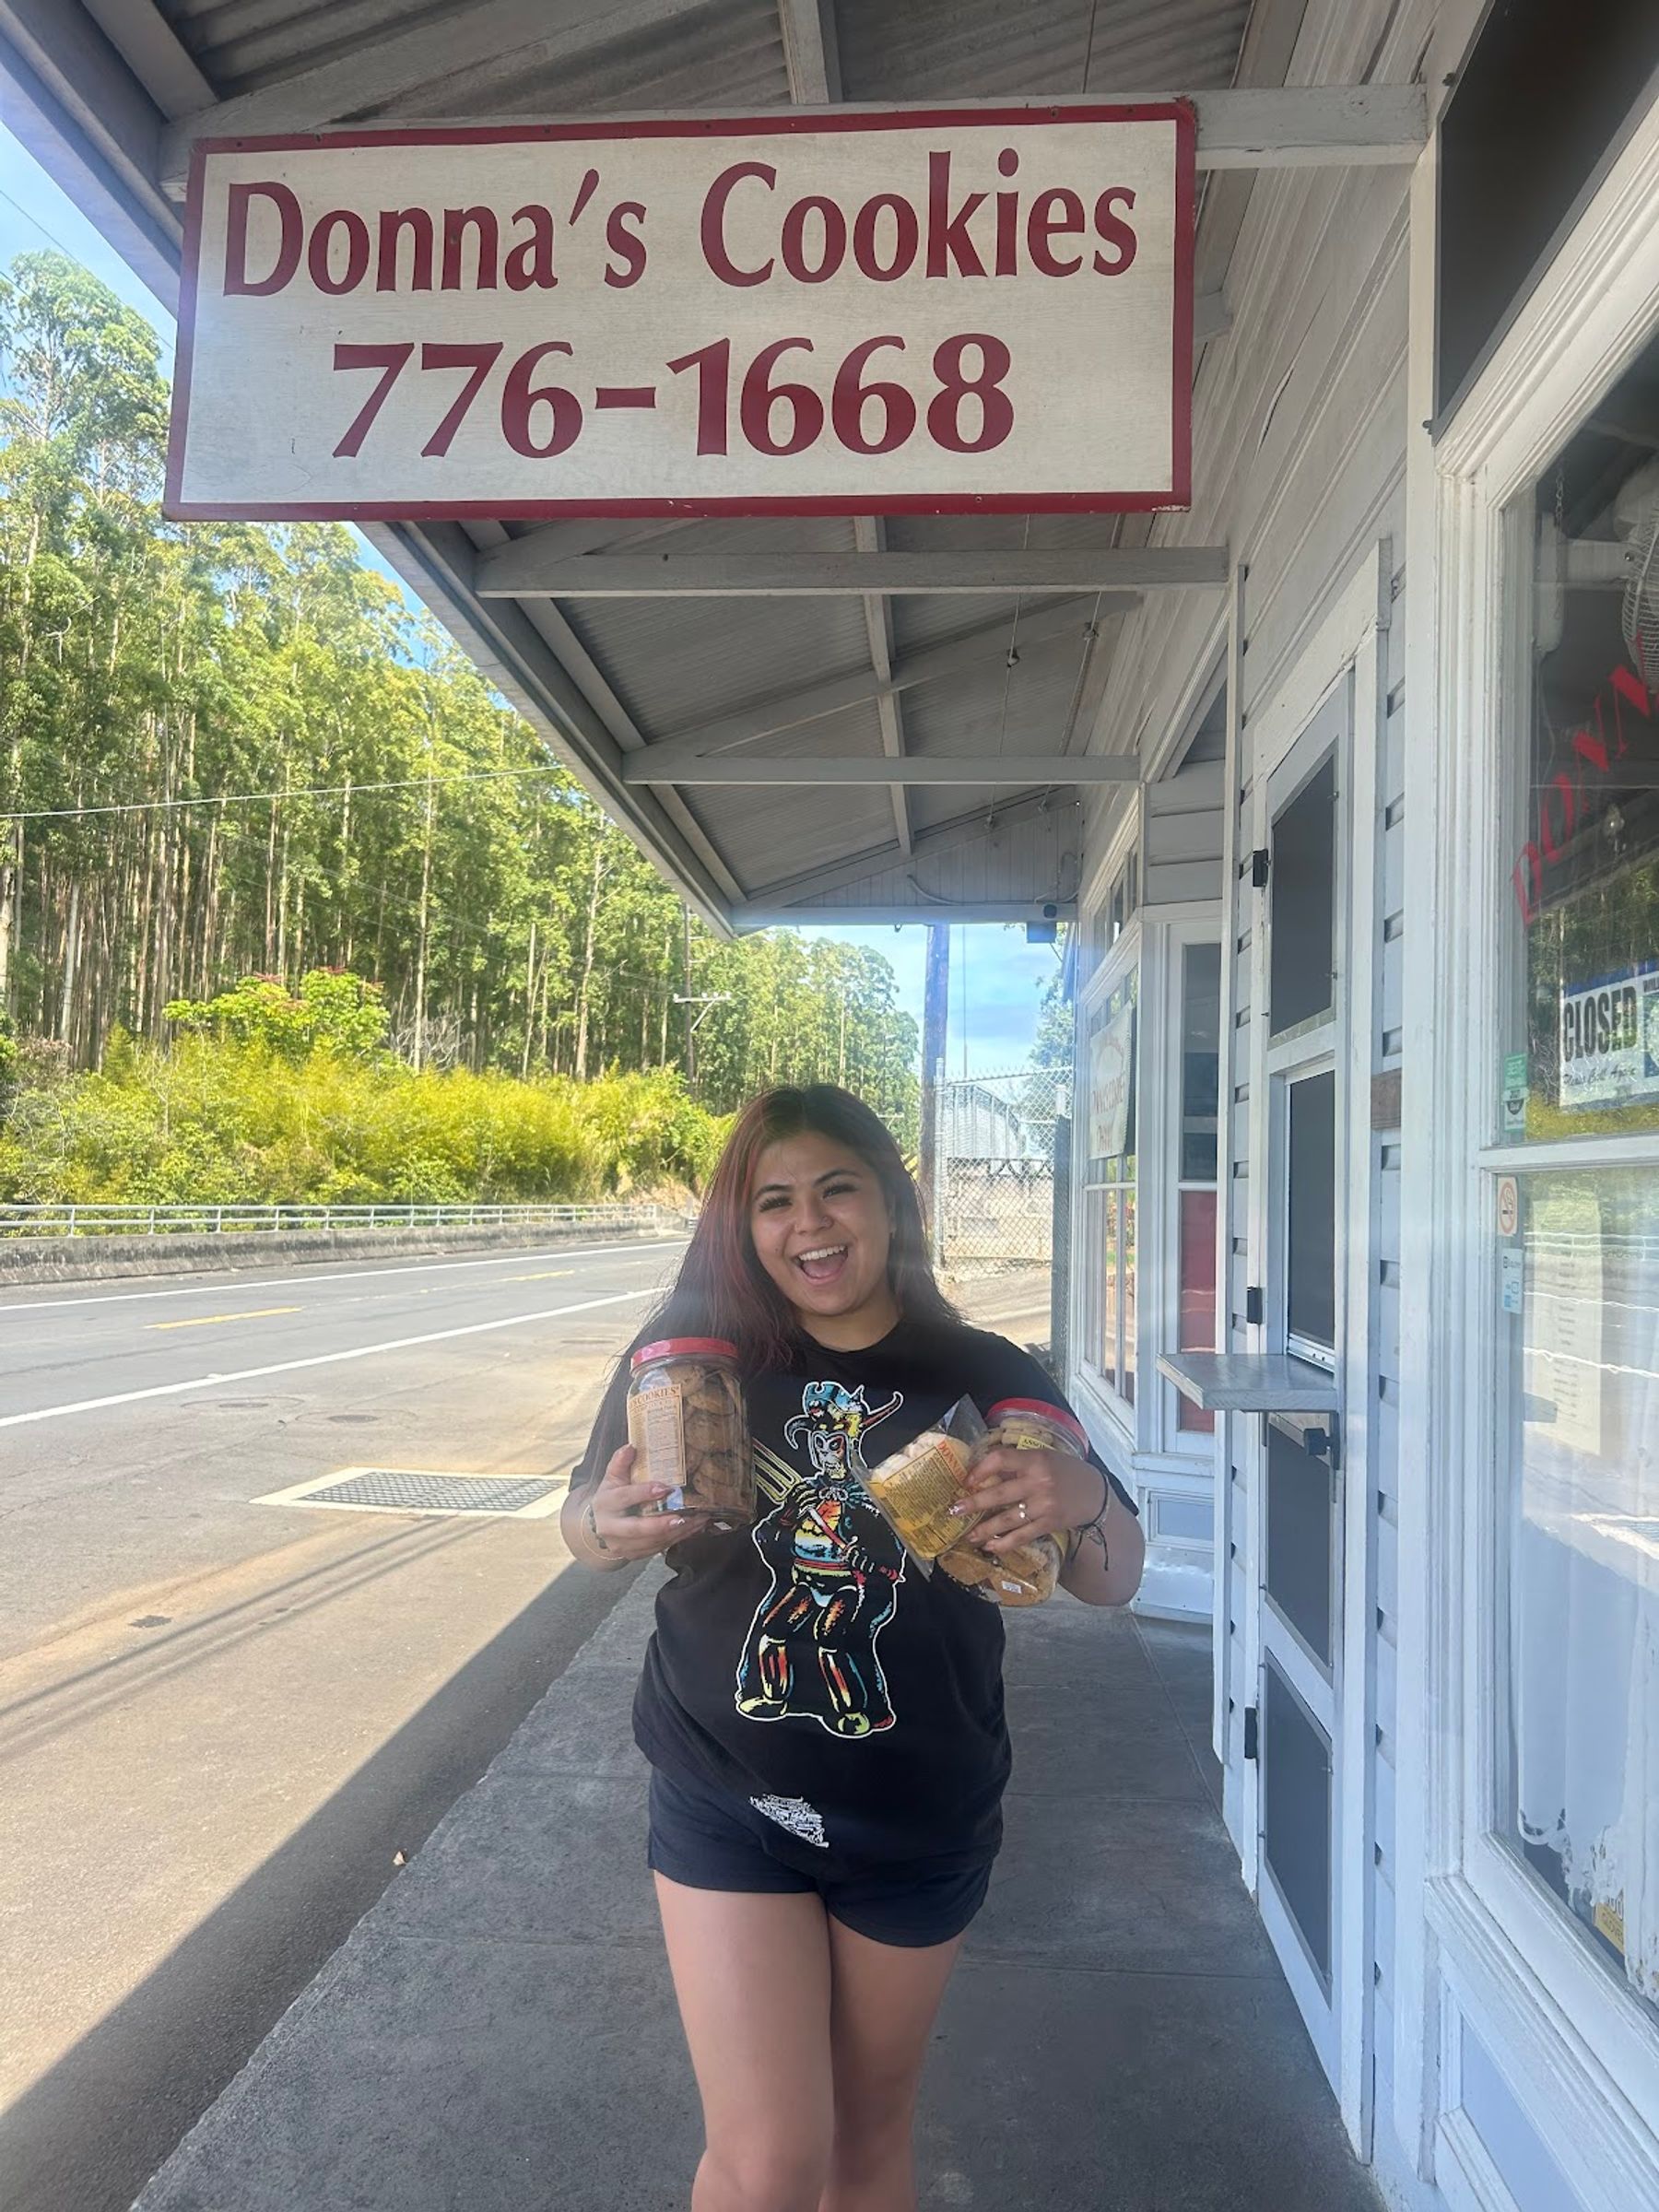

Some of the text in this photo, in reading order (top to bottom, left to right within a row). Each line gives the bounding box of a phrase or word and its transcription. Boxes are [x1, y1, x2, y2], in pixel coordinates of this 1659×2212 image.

[224, 148, 1138, 297] Donna's Cookies
[333, 334, 1015, 459] 776-1668
[1513, 627, 1659, 927] DONN
[1564, 986, 1638, 1063] CLOSED
